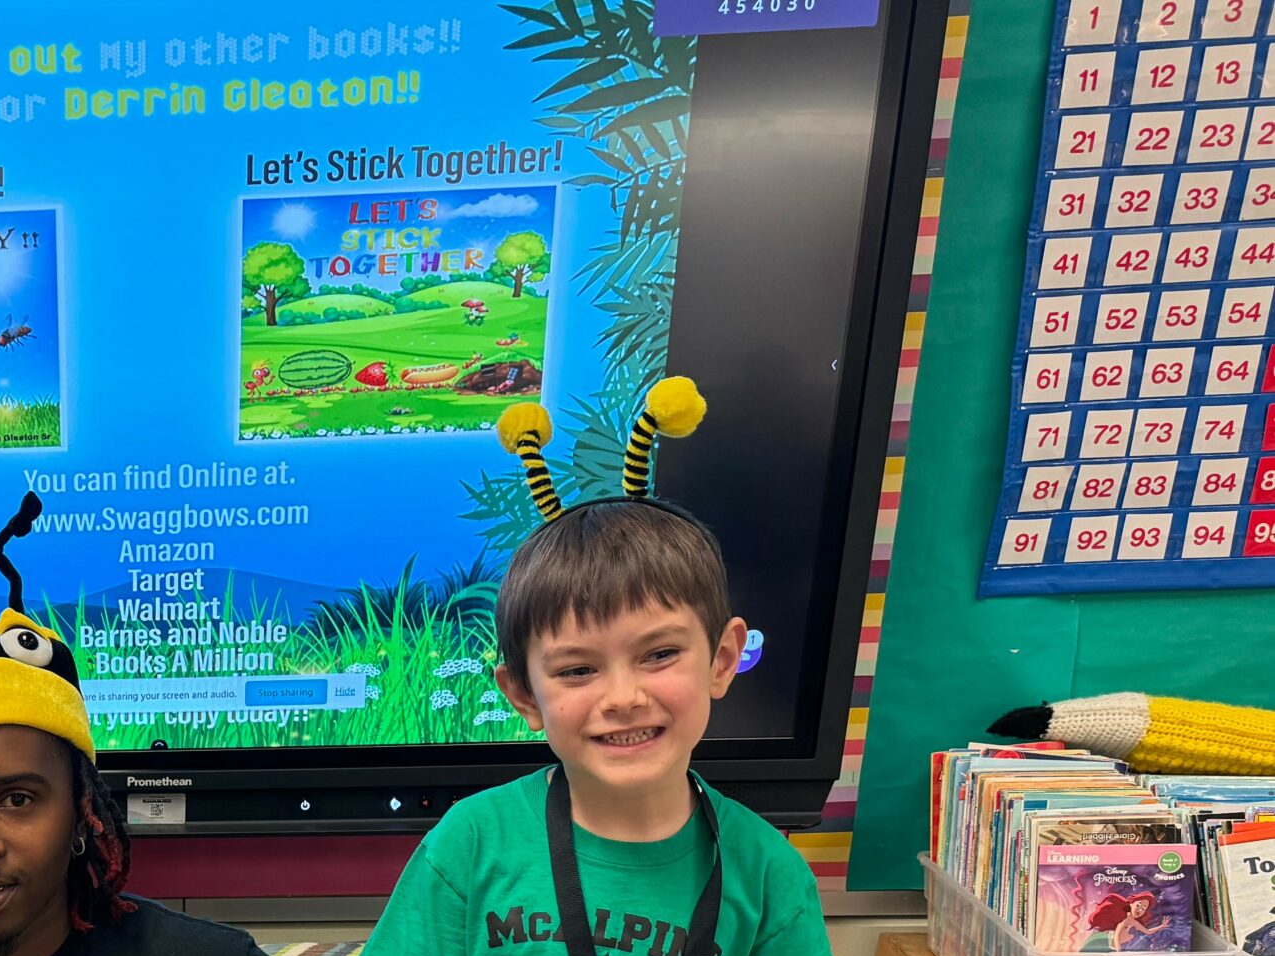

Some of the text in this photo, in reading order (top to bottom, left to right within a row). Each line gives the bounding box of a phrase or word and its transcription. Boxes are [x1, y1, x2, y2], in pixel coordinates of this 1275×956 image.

[1090, 0, 1243, 29] 1 2 3
[9, 42, 82, 76] out
[164, 31, 290, 67] other
[308, 18, 461, 60] books!!
[1079, 60, 1240, 91] 11 12 13
[65, 82, 205, 120] Derrin
[223, 70, 420, 112] Gleaton!!
[1070, 123, 1235, 153] 21 22 23
[245, 139, 563, 187] Let's Stick Together!
[349, 198, 437, 225] LET'S
[1058, 187, 1218, 216] 31 32 33
[341, 226, 442, 252] STICK
[309, 249, 484, 279] TOGETHER
[1053, 242, 1275, 275] 41 42 43 44
[1044, 302, 1261, 333] 51 52 53 54
[1036, 360, 1249, 390] 61 62 63 64
[1038, 420, 1235, 448] 71 72 73 74
[24, 461, 297, 494] You can find Online at.
[1032, 472, 1237, 500] 81 82 83 84
[119, 540, 215, 564] Amazon
[1013, 525, 1225, 553] 91 92 93 94
[128, 567, 205, 595] Target
[119, 597, 221, 623] Walmart
[80, 620, 287, 649] Barnes and Noble
[96, 647, 274, 675] Books A Million
[108, 691, 138, 702] sharing
[141, 692, 161, 702] your
[163, 691, 190, 700] screen
[192, 689, 207, 699] and
[210, 688, 237, 699] audio.
[258, 686, 314, 698] Stop sharing
[335, 685, 356, 697] Hide
[127, 776, 192, 788] Promethean
[1047, 855, 1100, 863] LEARNING
